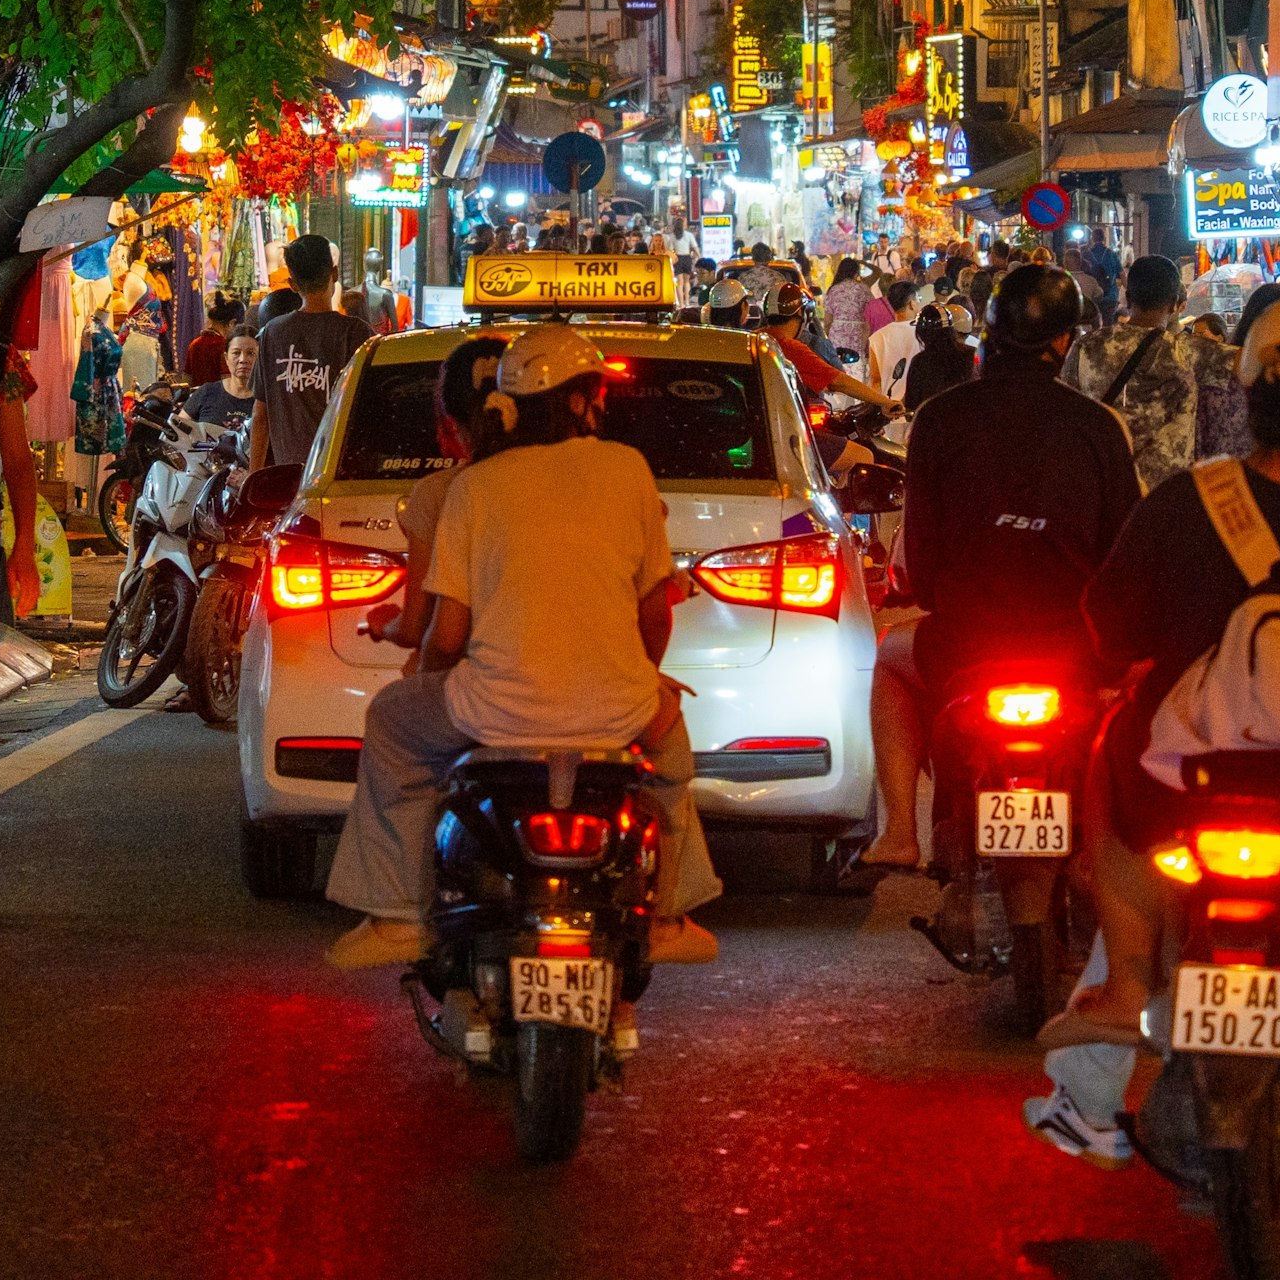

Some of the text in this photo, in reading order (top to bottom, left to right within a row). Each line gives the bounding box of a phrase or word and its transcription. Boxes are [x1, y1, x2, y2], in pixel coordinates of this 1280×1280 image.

[1212, 112, 1266, 121] RICE SPA
[1196, 172, 1247, 206] Spa
[1250, 200, 1280, 212] Body
[1197, 216, 1280, 231] Facial Waxing
[574, 262, 619, 276] TAXI
[537, 281, 656, 298] THANH NGA
[990, 795, 1055, 820] 26-AA
[983, 825, 1064, 850] 327.83
[1198, 972, 1278, 1010] 18-AA
